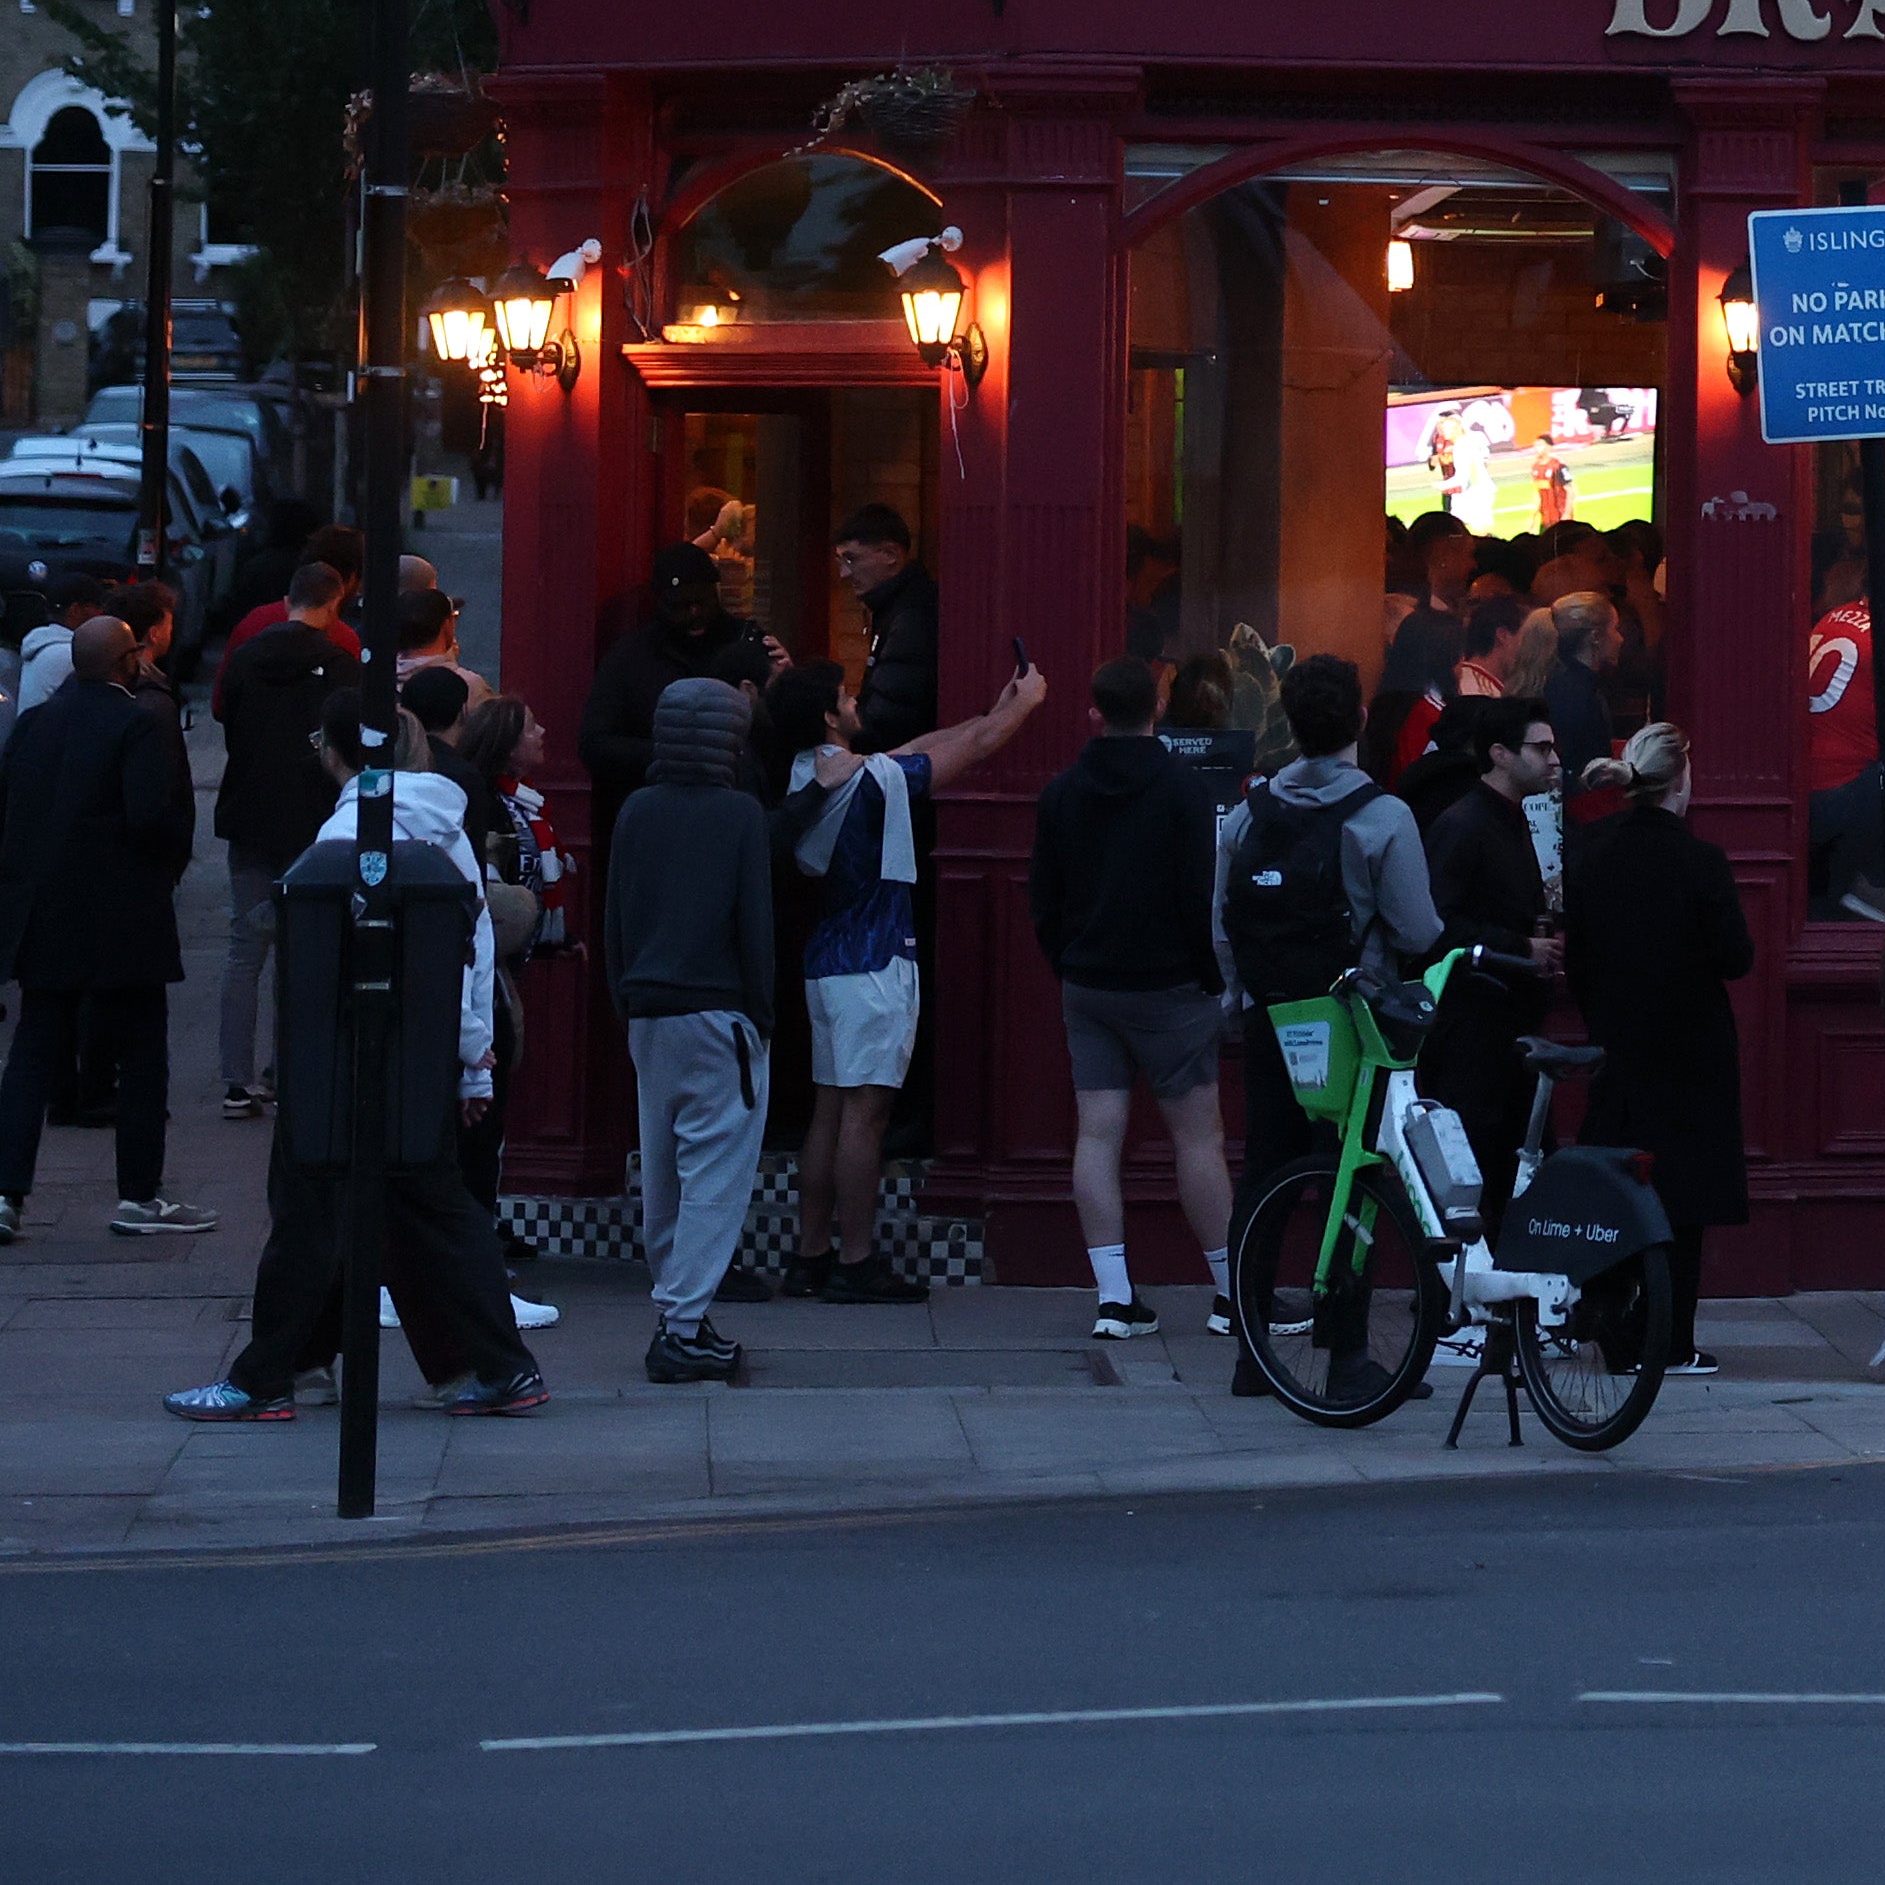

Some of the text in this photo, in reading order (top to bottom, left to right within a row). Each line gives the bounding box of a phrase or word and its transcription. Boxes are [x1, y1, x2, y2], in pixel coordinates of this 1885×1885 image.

[1792, 292, 1827, 314] NO
[1769, 325, 1805, 347] ON
[1795, 380, 1860, 400] STREET
[1808, 405, 1860, 423] PITCH
[1809, 633, 1859, 714] 0
[1528, 1218, 1542, 1235] On
[1542, 1219, 1570, 1238] Lime
[1585, 1224, 1620, 1243] Uber
